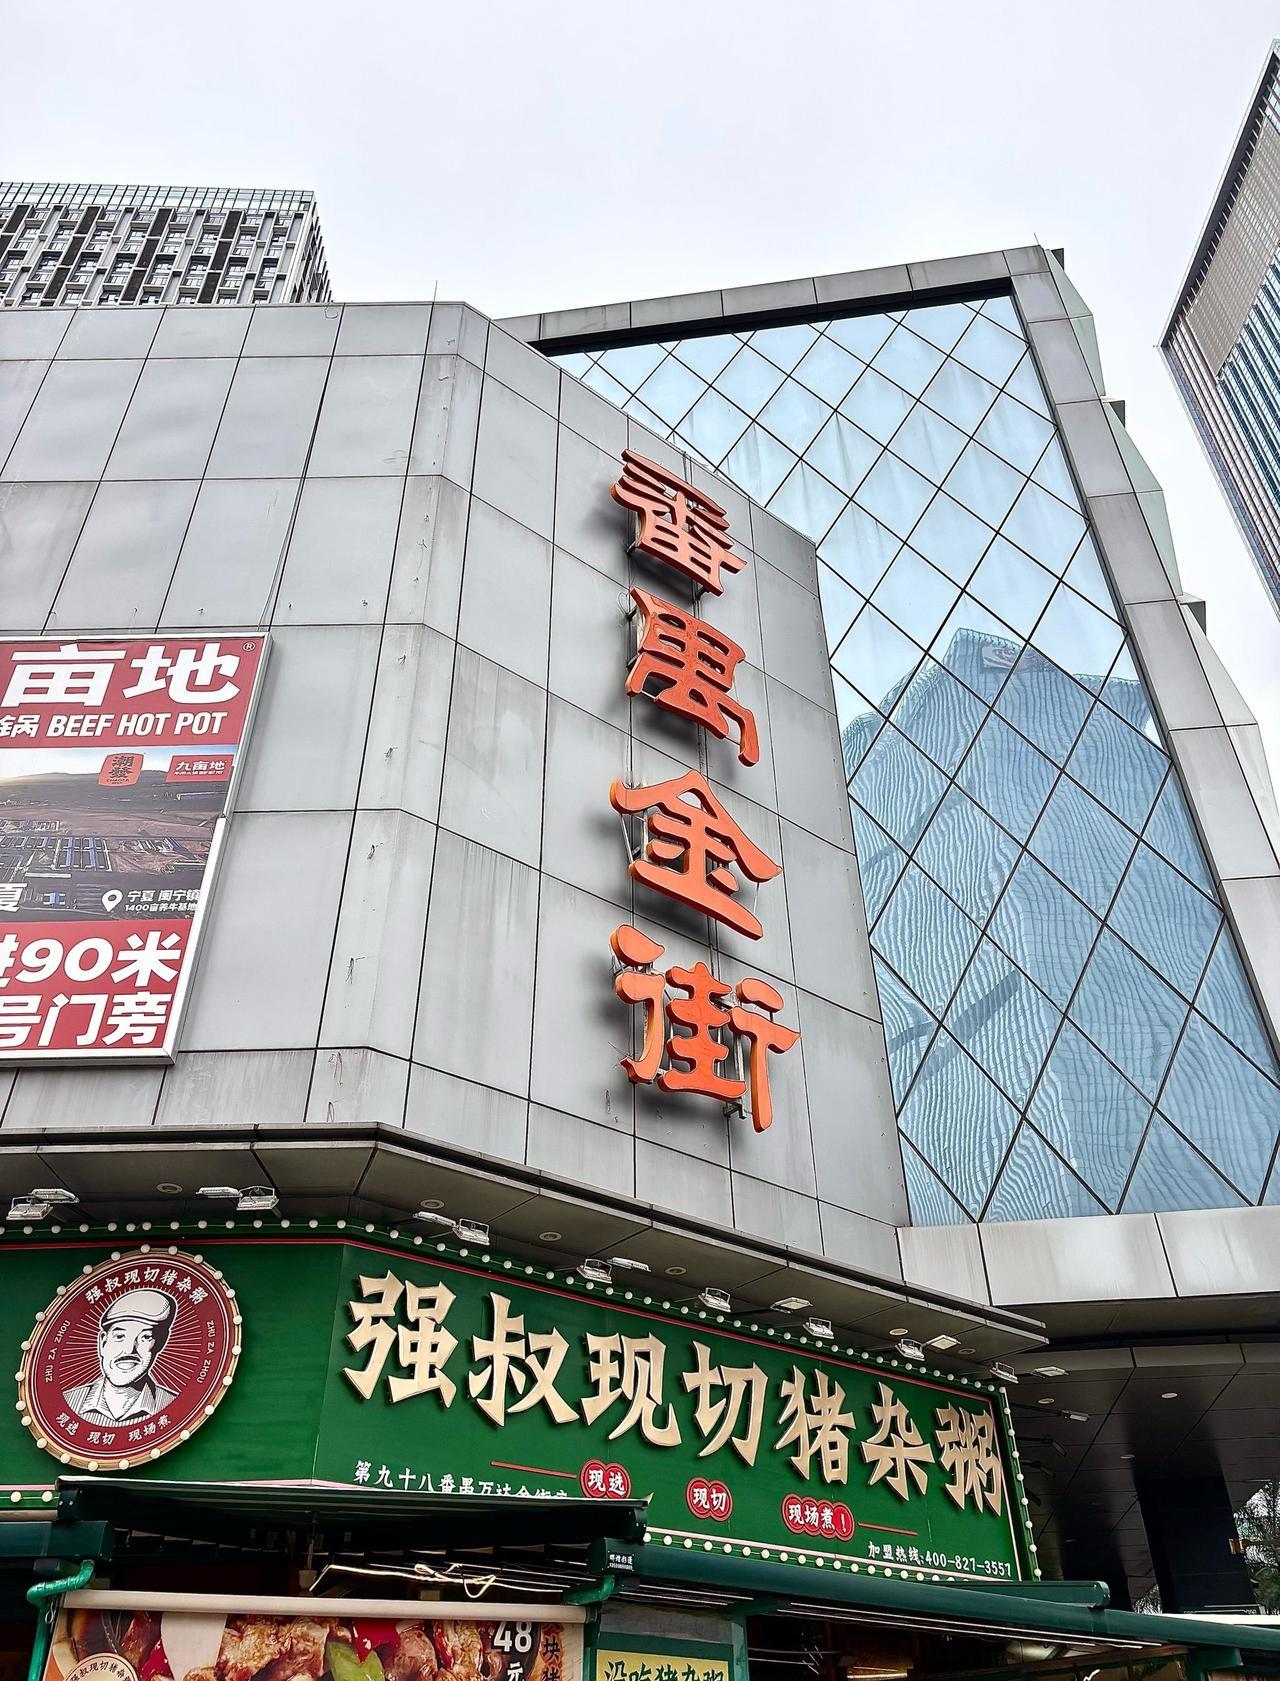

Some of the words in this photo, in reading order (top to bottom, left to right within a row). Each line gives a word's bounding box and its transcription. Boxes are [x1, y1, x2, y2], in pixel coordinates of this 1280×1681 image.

[1, 643, 241, 708] 亩地
[0, 714, 40, 738] 锅
[46, 714, 116, 738] BEEF
[116, 712, 171, 737] HOT
[174, 711, 228, 736] POT
[176, 761, 225, 771] 九亩地
[611, 448, 801, 1132] 番禺金街
[0, 991, 173, 1047] 号门旁
[84, 1266, 209, 1305] 强叔现切猪杂粥
[54, 1320, 71, 1344] ZHOU
[206, 1320, 216, 1338] ZHU
[48, 1347, 57, 1361] ZA
[206, 1341, 215, 1355] ZA
[45, 1364, 54, 1383] ZHU
[196, 1359, 212, 1384] ZHOU
[343, 1269, 1001, 1517] 强叔现切猪杂粥
[87, 1431, 116, 1446] 现切
[587, 1469, 626, 1499] 现选
[692, 1487, 728, 1512] 现切
[494, 1621, 532, 1653] 48
